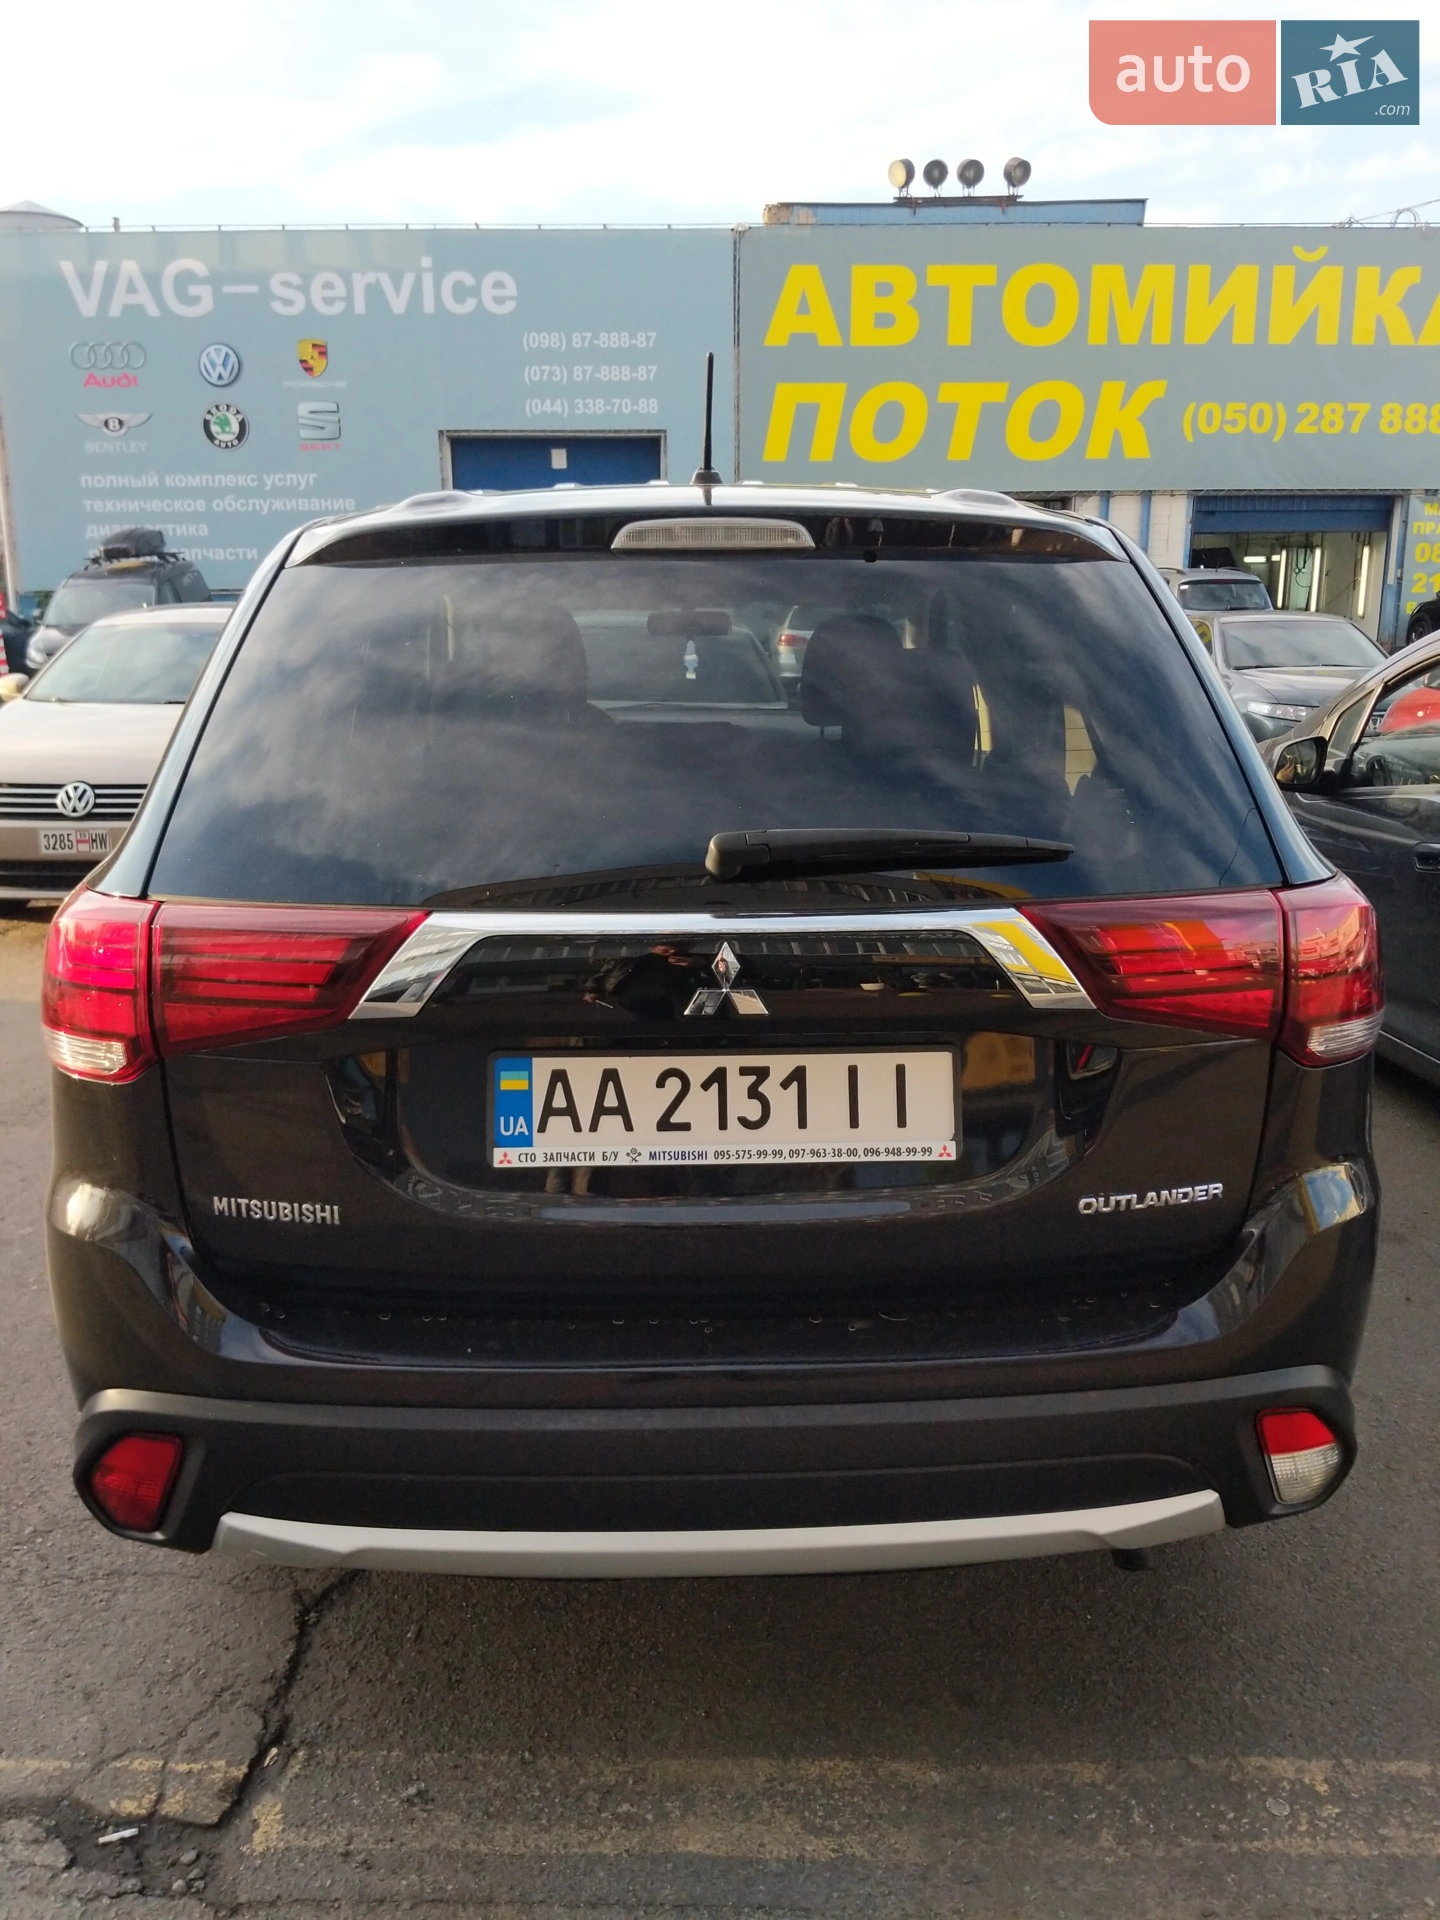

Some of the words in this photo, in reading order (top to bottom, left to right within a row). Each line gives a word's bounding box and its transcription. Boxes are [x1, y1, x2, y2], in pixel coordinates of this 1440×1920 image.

[523, 332, 566, 352] (098)
[572, 332, 657, 348] 87-888-87
[83, 372, 138, 388] Audi
[525, 365, 567, 385] (073)
[573, 365, 658, 381] 87-888-87
[526, 398, 568, 418] (044)
[575, 399, 658, 414] 338-70-88
[762, 380, 1167, 462] ПОТОК
[1183, 402, 1287, 441] (050)
[1294, 402, 1371, 434] 287
[85, 441, 147, 453] BENTLEY
[81, 473, 159, 488] полный
[165, 474, 258, 489] комплекс
[265, 474, 317, 492] услуг
[82, 500, 206, 513] техническое
[212, 495, 356, 515] обслуживание
[43, 833, 74, 850] 3285
[90, 833, 108, 849] HW
[656, 1065, 808, 1132] 2131
[500, 1117, 528, 1136] UA
[518, 1152, 536, 1163] СТО
[543, 1150, 595, 1162] ЗАПЧАСТИ
[602, 1150, 619, 1161] Б/У
[648, 1150, 708, 1161] MITSUBISHI
[713, 1148, 787, 1160] 095-575-99-99,
[788, 1147, 861, 1160] 097-963-38-00,
[863, 1146, 933, 1158] 096-948-99-99
[1078, 1182, 1224, 1215] OUTLANDER
[213, 1196, 341, 1225] MITSUBISHI
